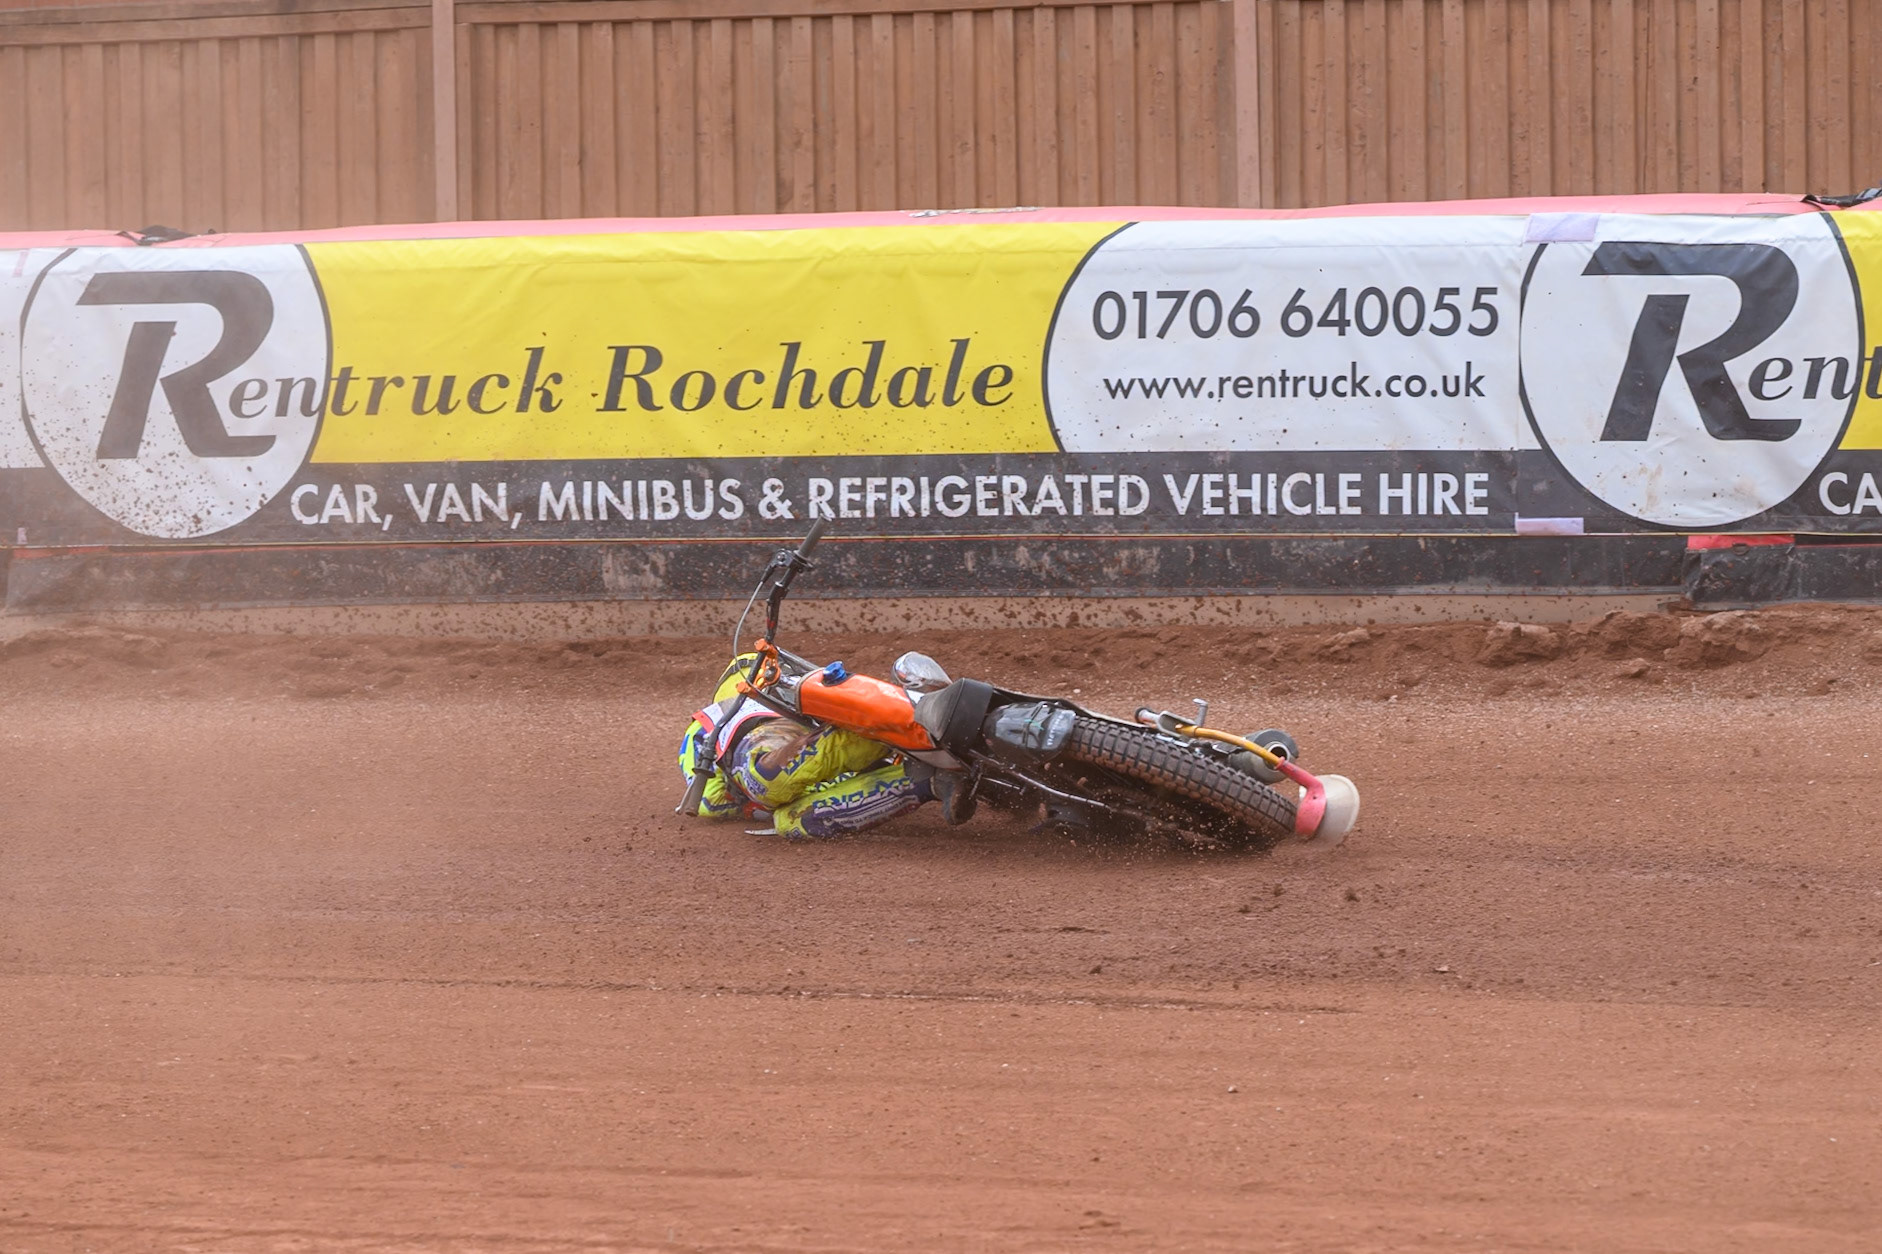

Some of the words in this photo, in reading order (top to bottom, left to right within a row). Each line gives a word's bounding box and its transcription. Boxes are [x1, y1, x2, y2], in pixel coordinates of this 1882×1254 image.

[1092, 288, 1260, 341] 01706
[1280, 286, 1498, 339] 640055
[76, 270, 564, 460] Rentruck
[596, 338, 1014, 412] Rochdale
[1103, 361, 1486, 399] www.rentruck.co.uk
[290, 483, 391, 530] CAR,
[404, 481, 521, 529] VAN,
[538, 477, 745, 521] MINIBUS
[757, 478, 793, 519] &
[808, 473, 1151, 519] REFRIGERATED
[1163, 473, 1362, 516] VEHICLE
[1379, 473, 1489, 516] HIRE
